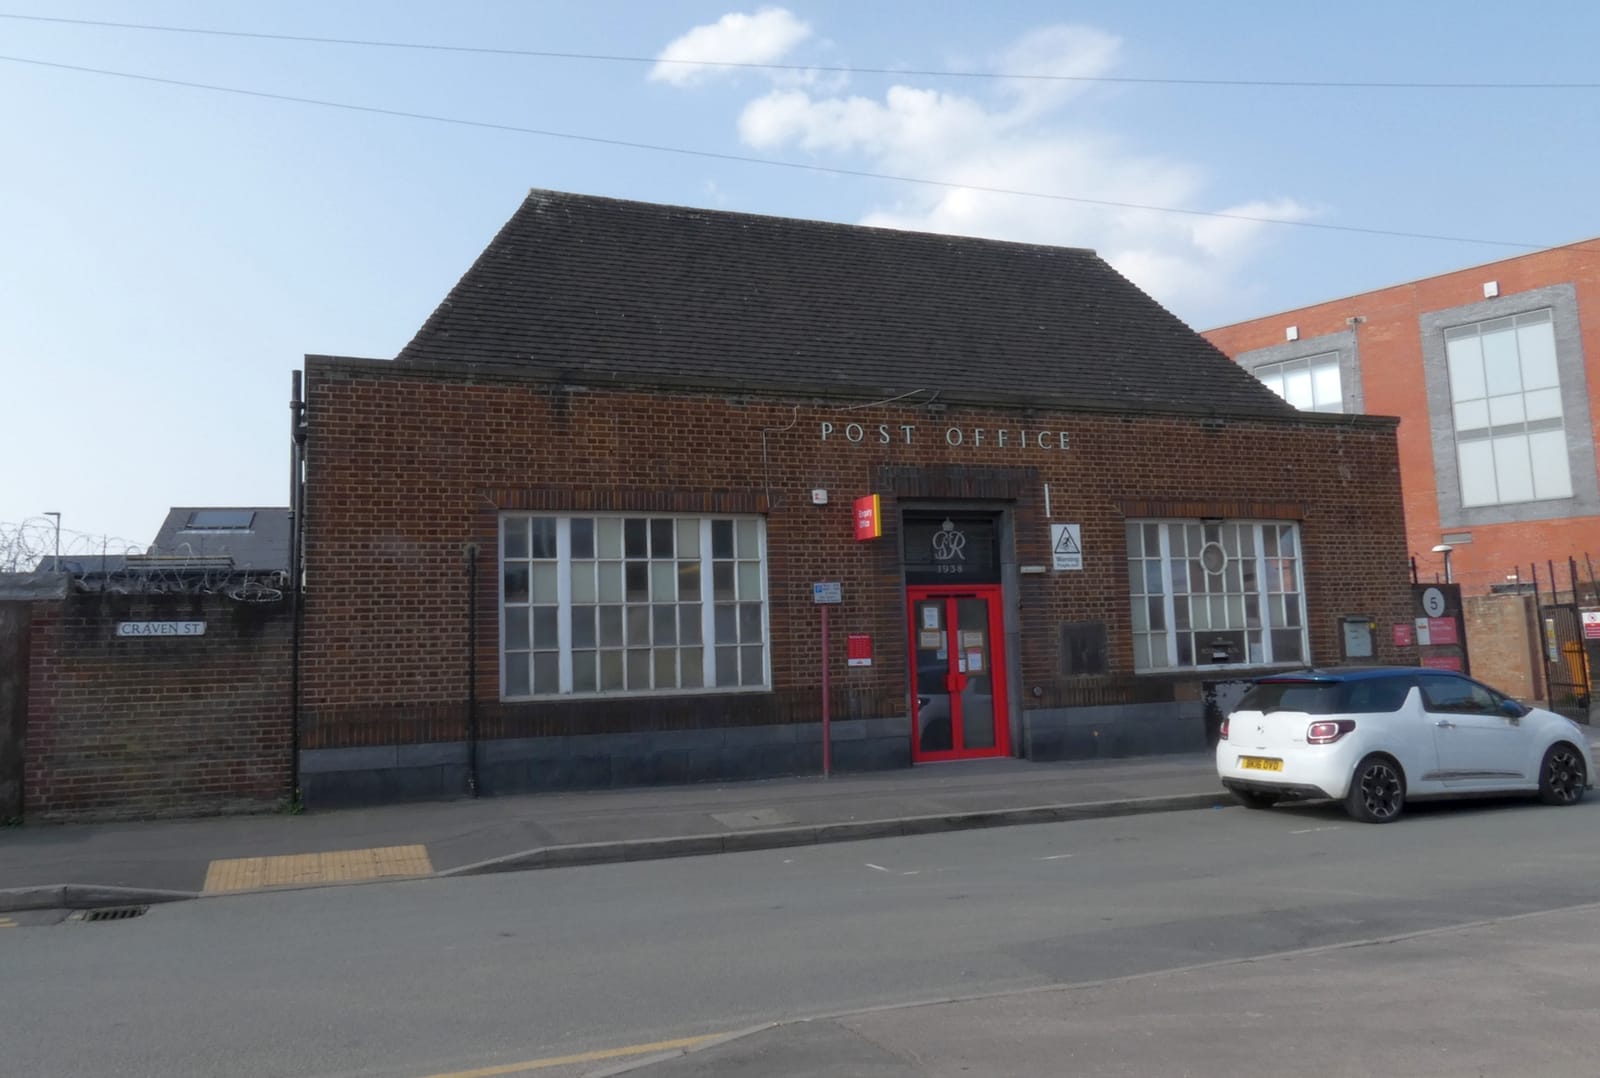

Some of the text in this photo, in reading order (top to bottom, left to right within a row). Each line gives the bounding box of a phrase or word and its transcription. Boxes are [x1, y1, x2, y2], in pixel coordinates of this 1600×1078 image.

[821, 422, 1070, 450] POST OFFICE
[936, 564, 963, 574] 1938
[1430, 596, 1438, 611] 5
[121, 623, 200, 635] CRAVEN ST
